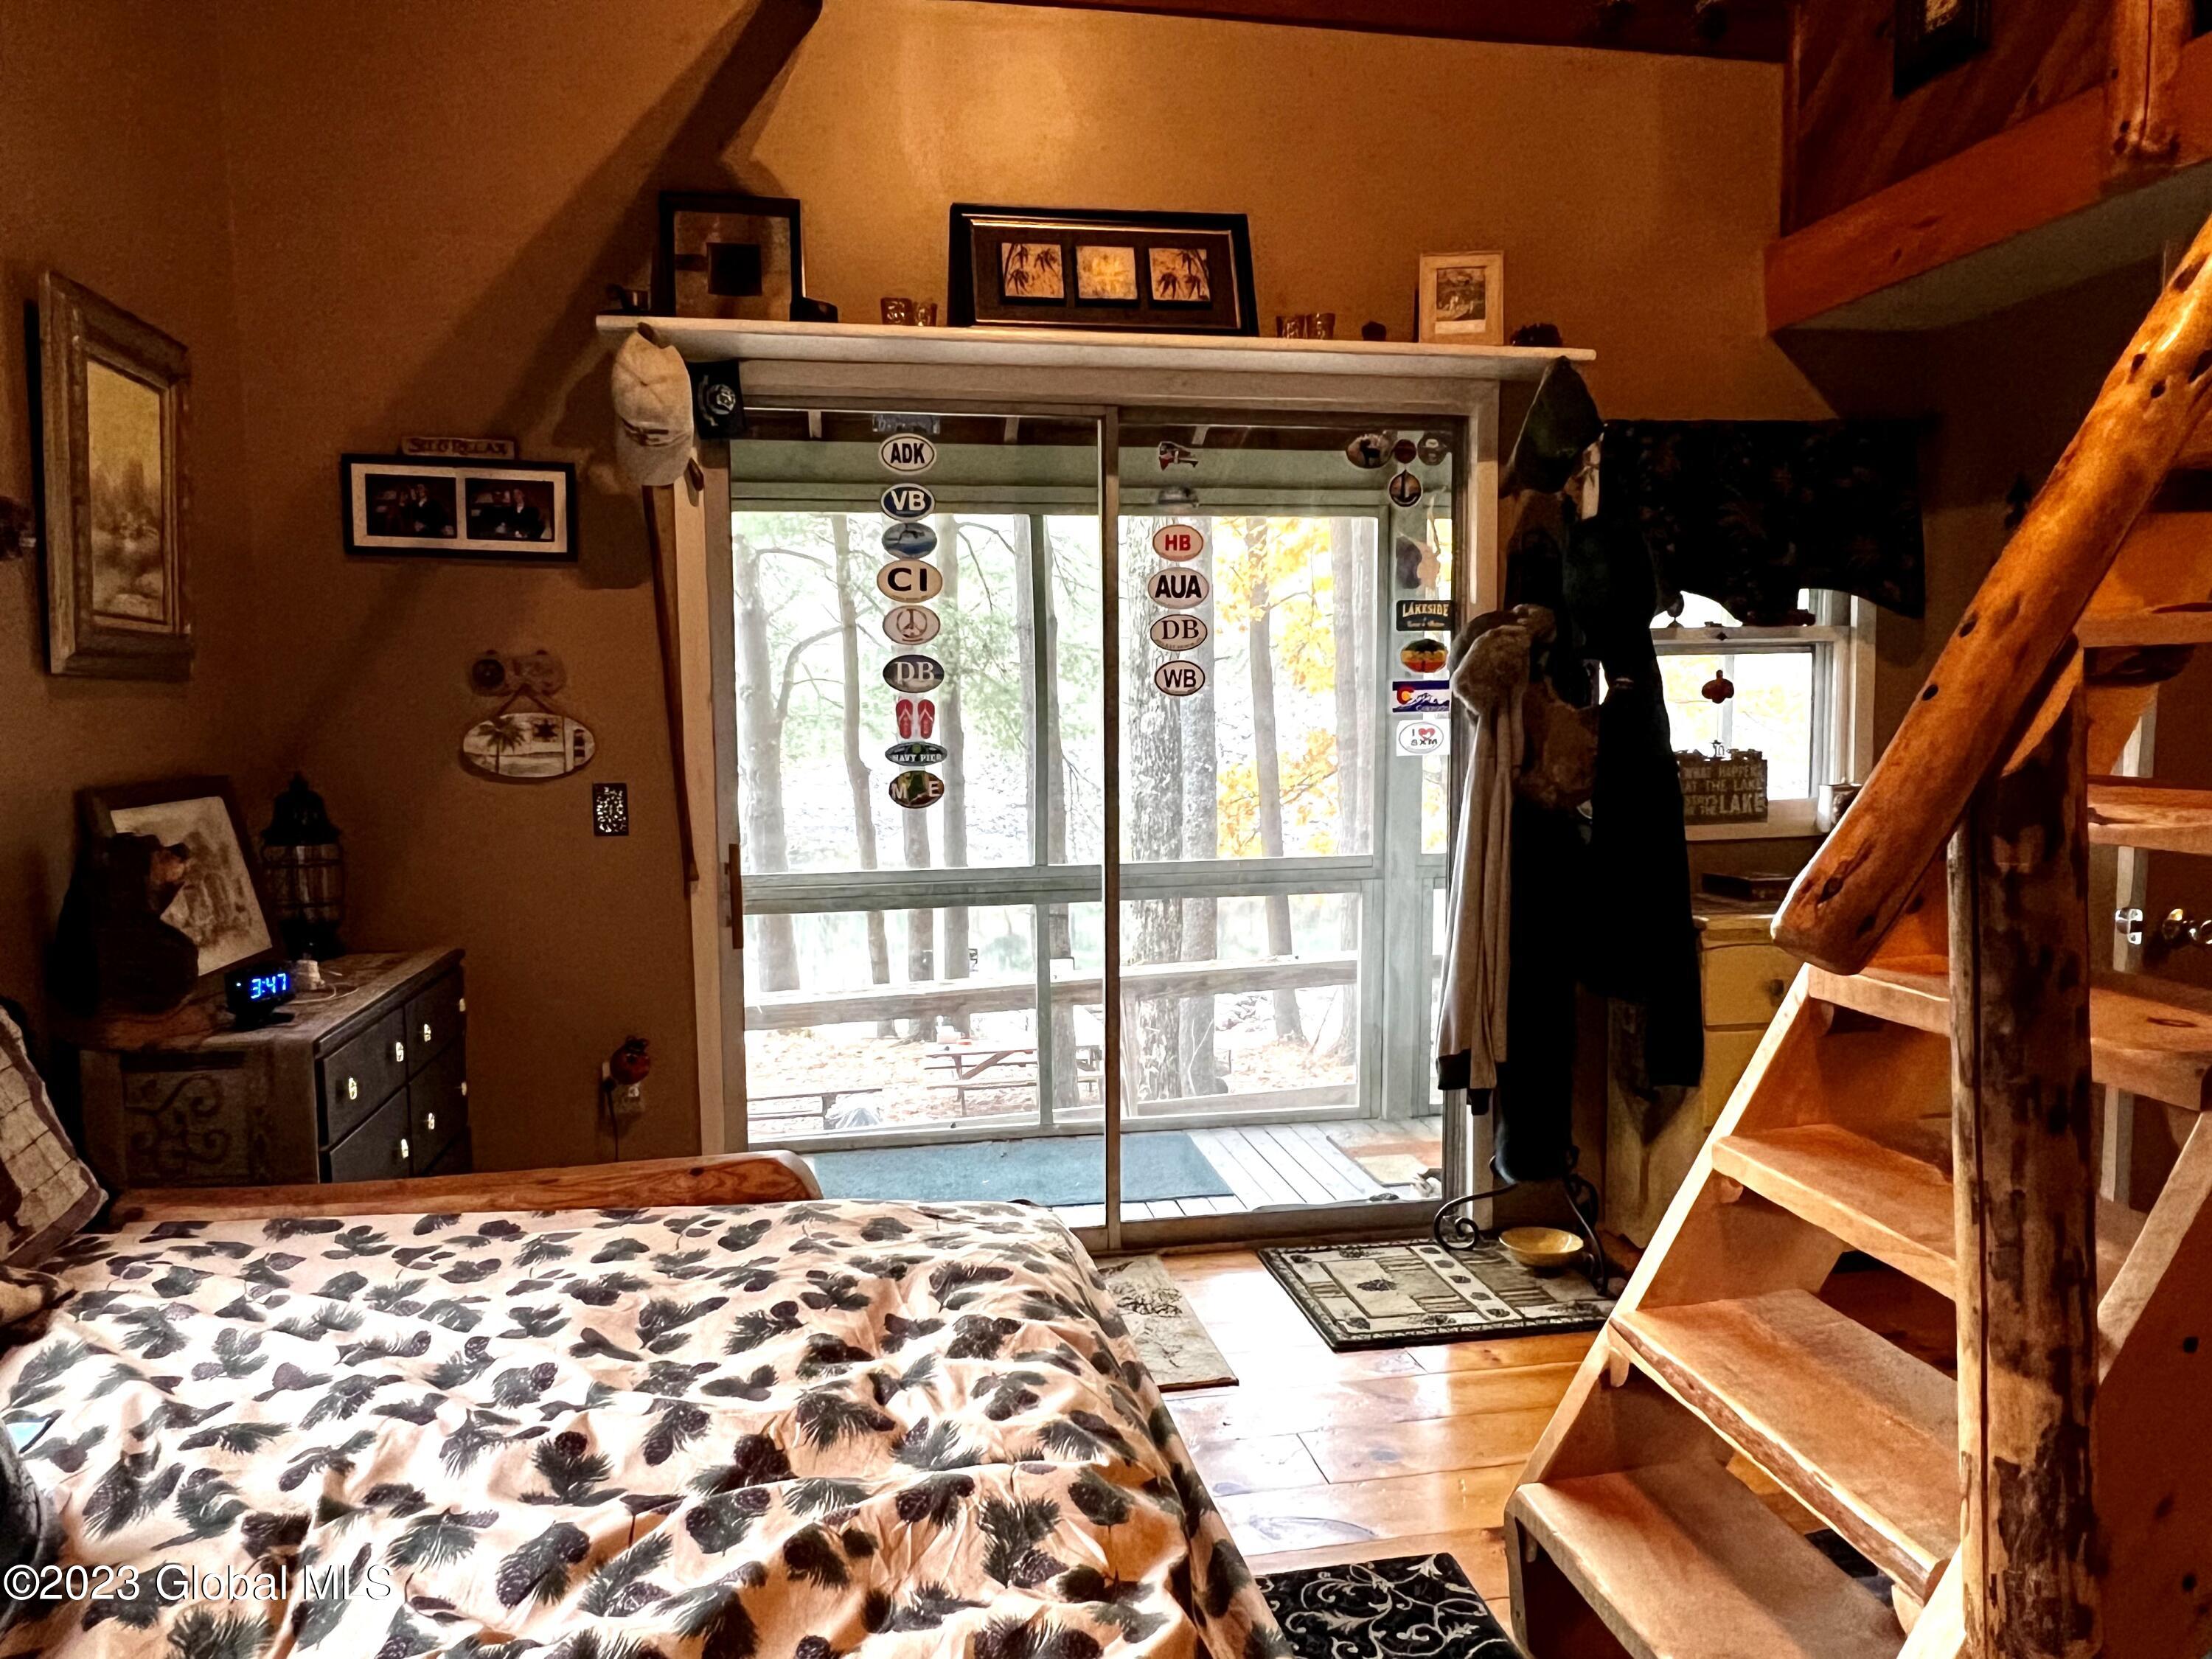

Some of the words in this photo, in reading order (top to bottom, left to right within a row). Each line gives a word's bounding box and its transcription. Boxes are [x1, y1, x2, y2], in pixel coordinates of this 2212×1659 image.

[890, 442, 925, 465] ADK
[891, 490, 927, 511] VB
[1165, 535, 1191, 551] HB
[887, 567, 928, 592] CI
[1155, 574, 1202, 599] AUA
[1402, 601, 1450, 617] LAKESIDE
[1161, 619, 1200, 640] DB
[894, 661, 935, 684] DB
[1163, 669, 1197, 688] WB
[891, 754, 917, 762] NAVY
[1684, 779, 1697, 793] AT
[1706, 779, 1727, 792] THE
[1733, 778, 1763, 791] LAKE
[1719, 793, 1764, 814] LAKE
[250, 973, 287, 999] 3:47
